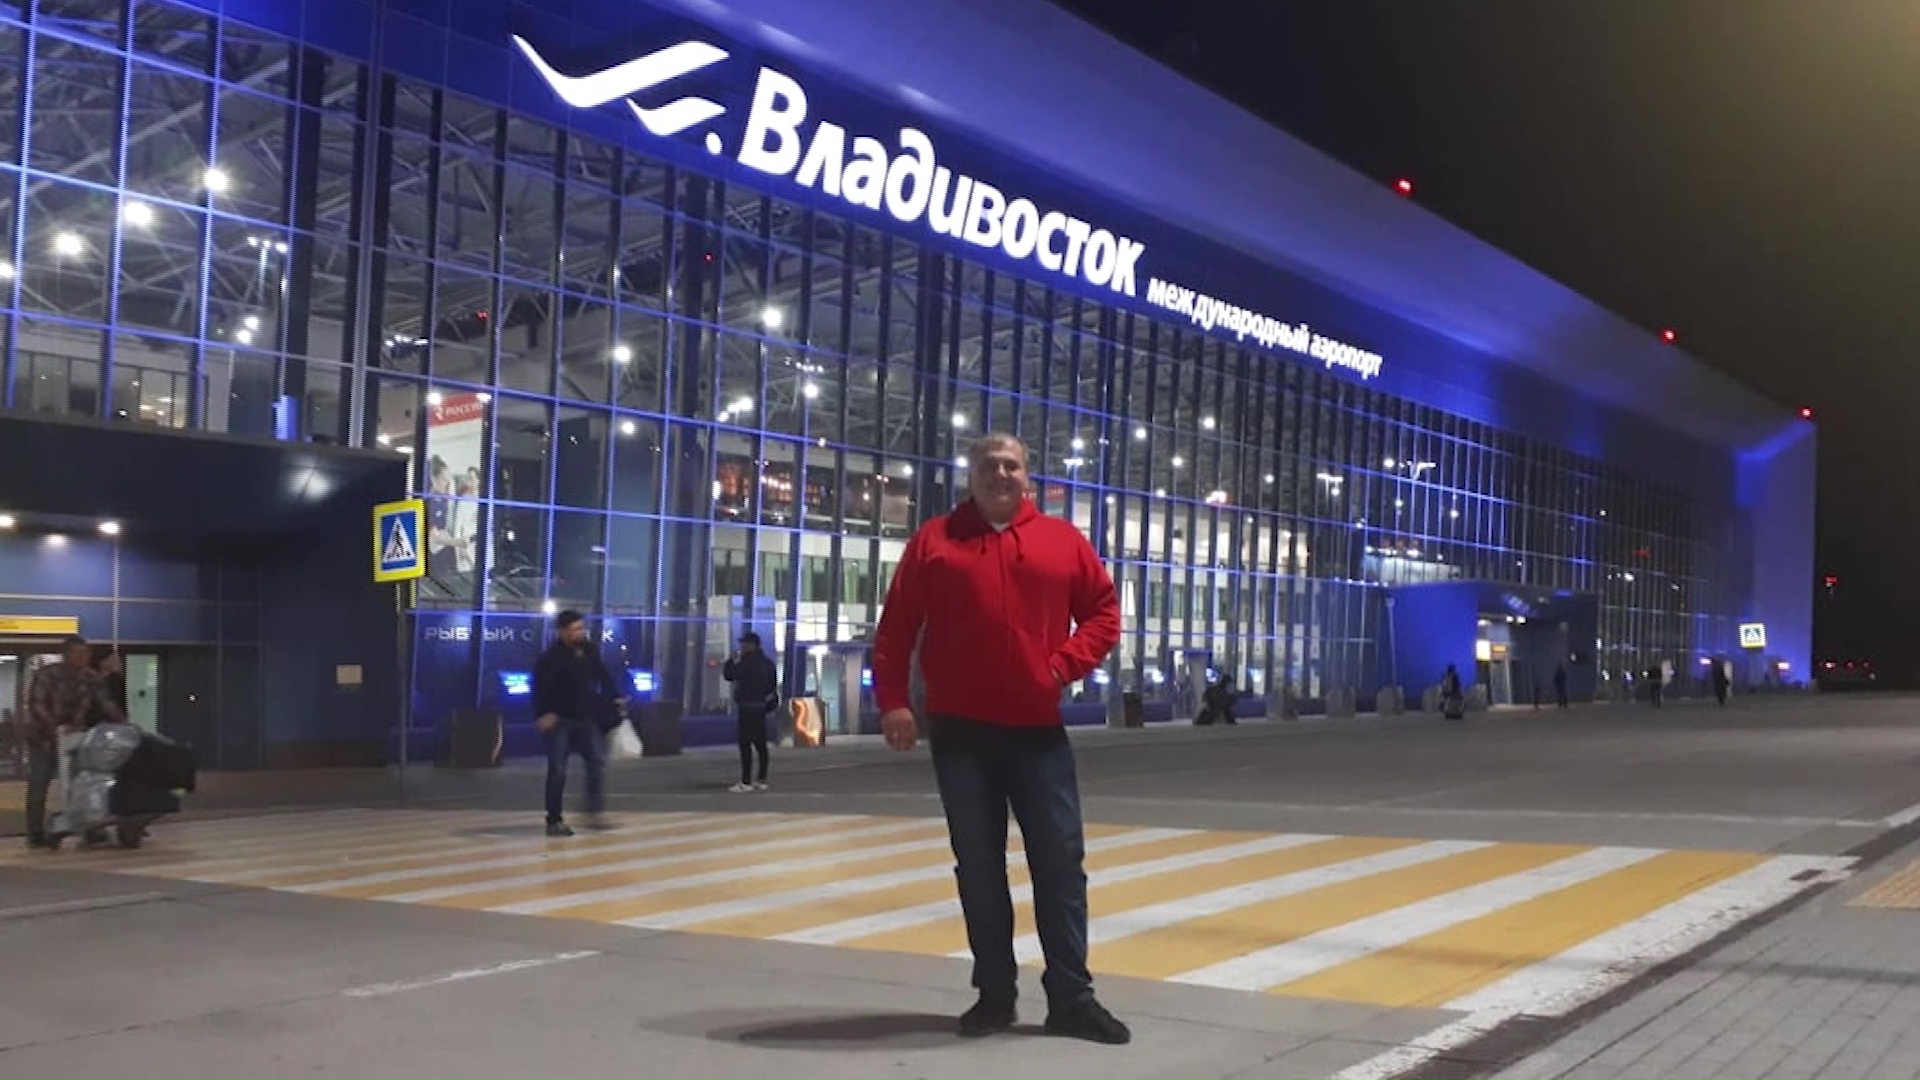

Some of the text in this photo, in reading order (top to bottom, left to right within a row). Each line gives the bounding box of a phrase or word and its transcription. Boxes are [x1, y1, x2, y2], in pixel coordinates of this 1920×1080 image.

[737, 66, 1145, 297] Владивосток
[1147, 277, 1383, 380] международный аэропорт
[424, 626, 514, 642] РЫБЫЙ
